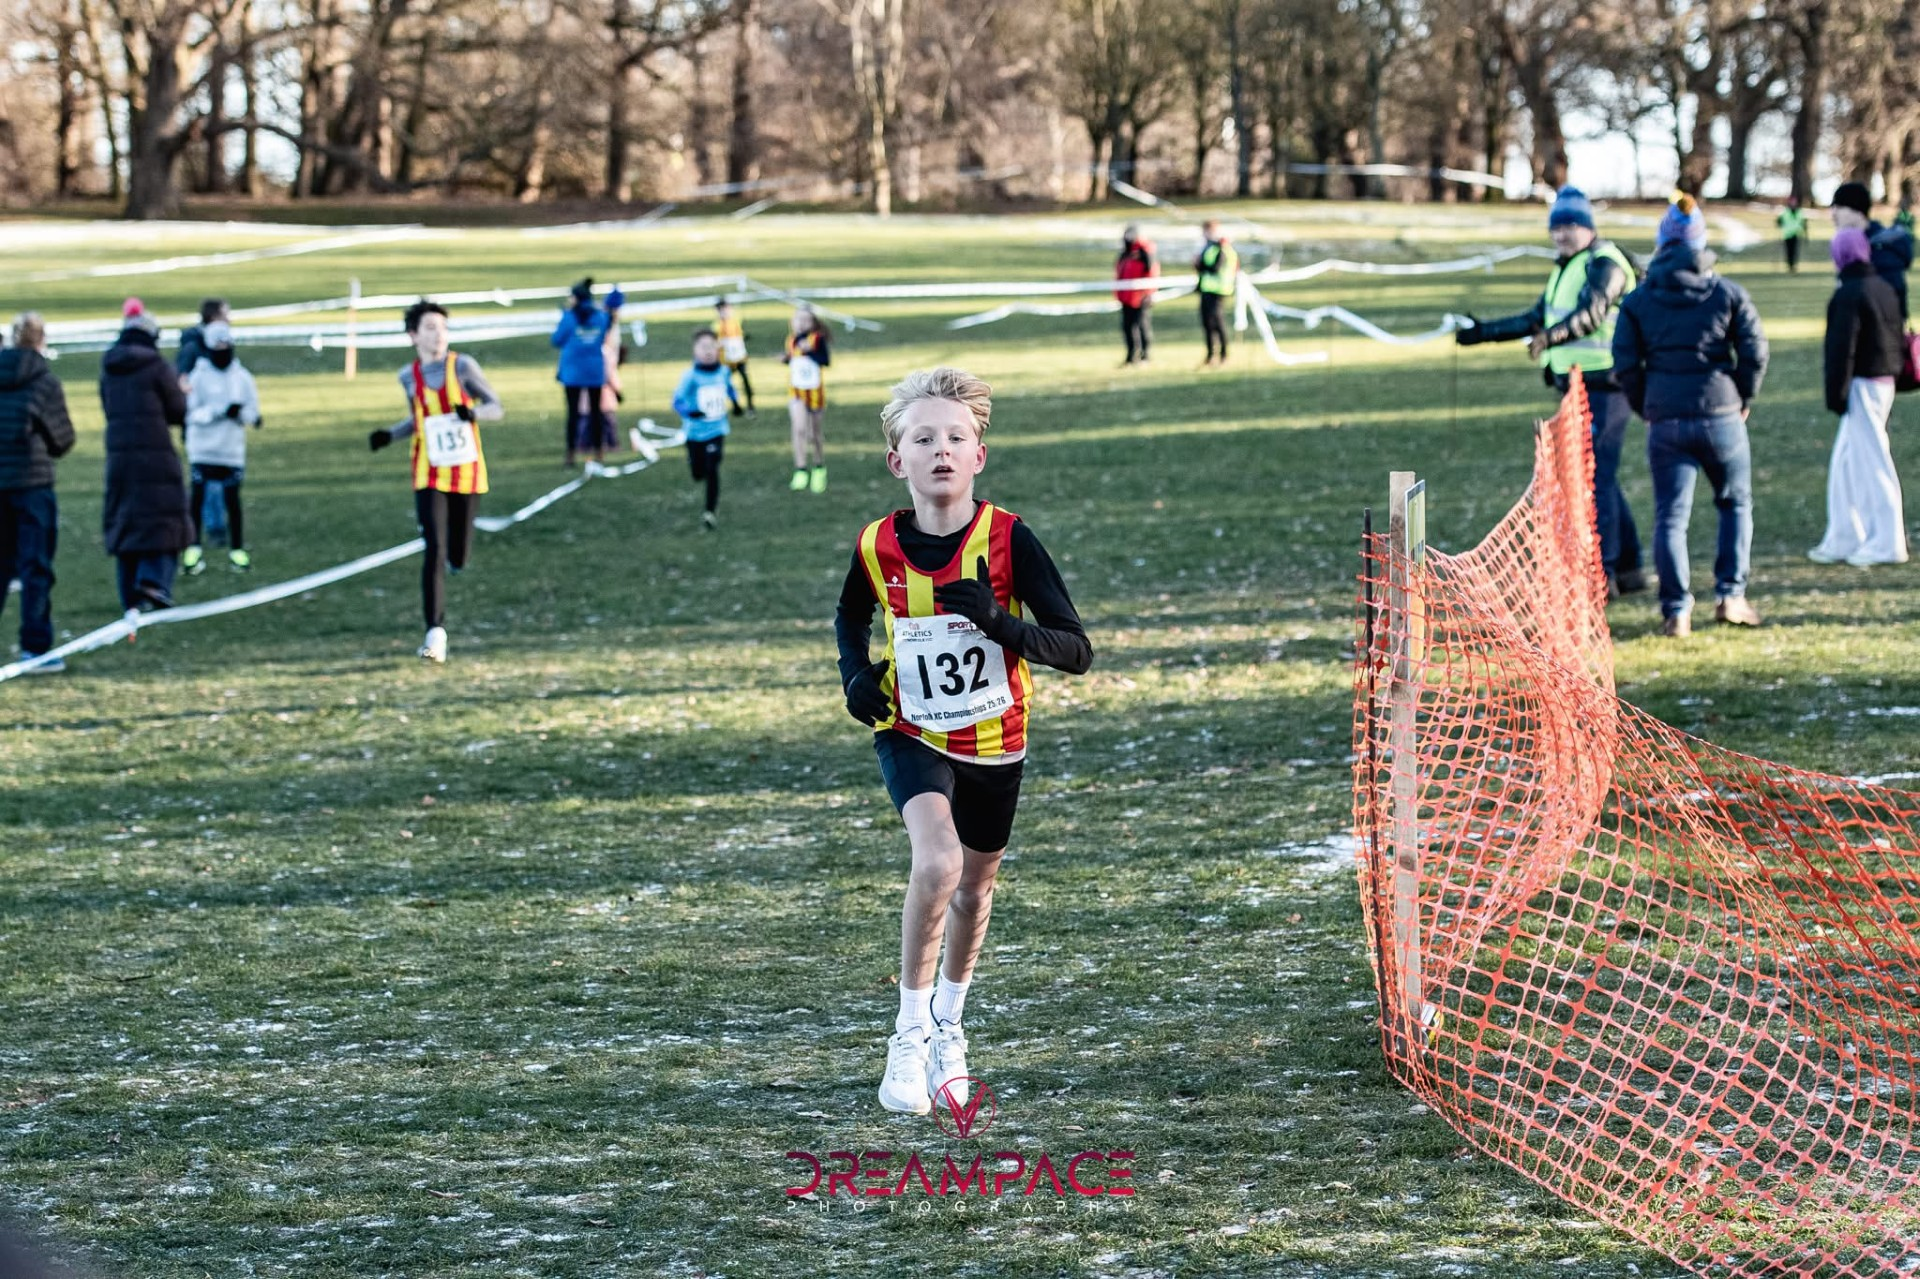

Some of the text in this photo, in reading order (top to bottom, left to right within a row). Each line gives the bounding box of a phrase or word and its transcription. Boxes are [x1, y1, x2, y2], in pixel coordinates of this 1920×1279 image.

[437, 426, 466, 451] 135
[917, 646, 989, 700] 132
[911, 713, 934, 722] Norfolk
[934, 712, 943, 720] XC
[943, 704, 987, 720] Championships
